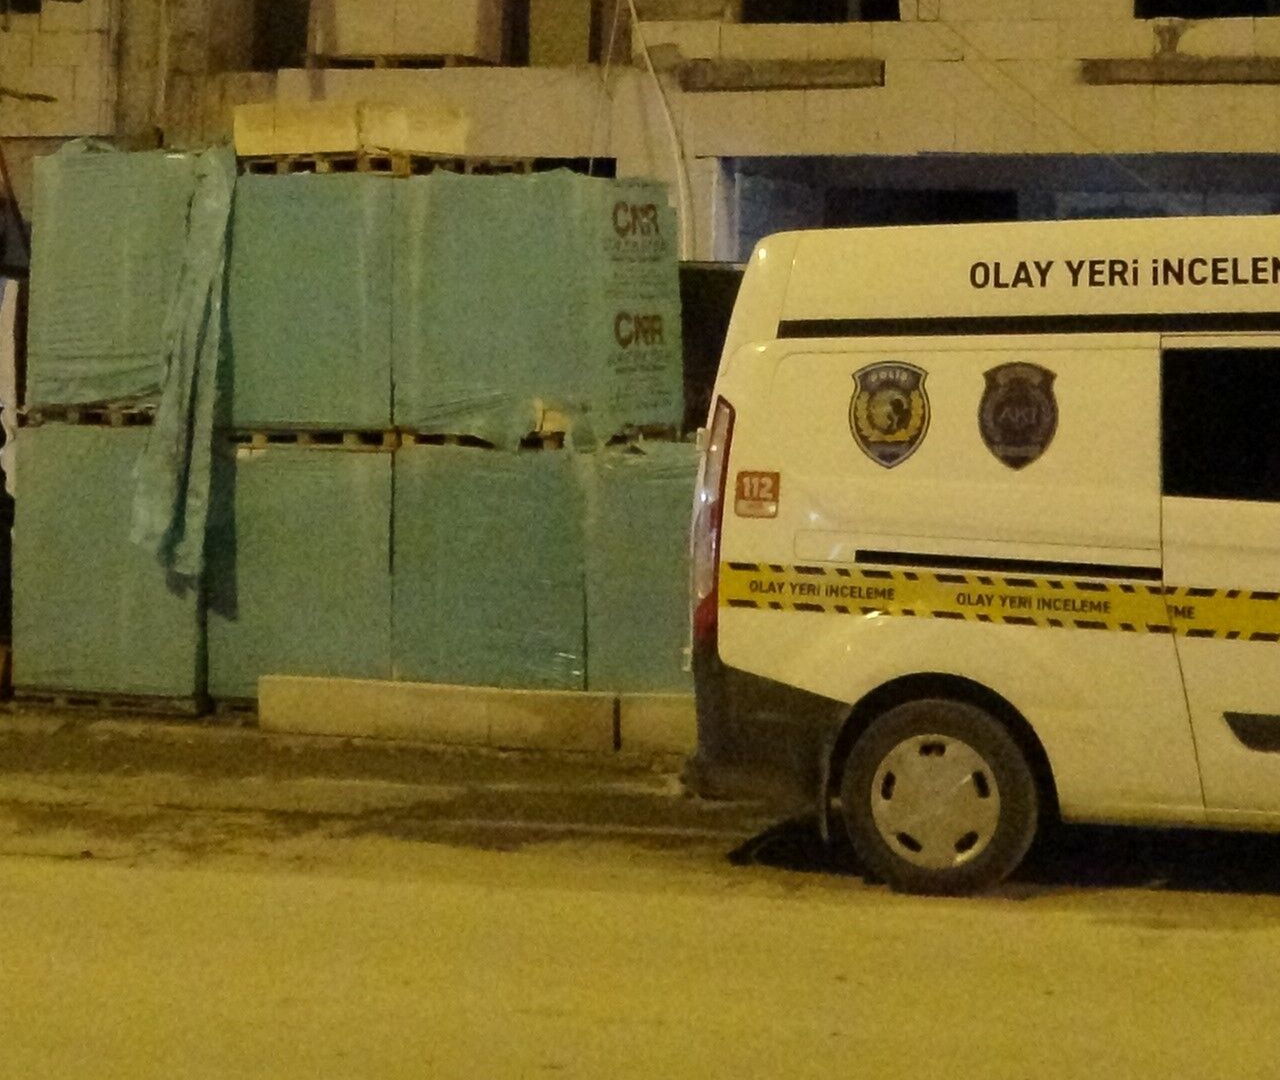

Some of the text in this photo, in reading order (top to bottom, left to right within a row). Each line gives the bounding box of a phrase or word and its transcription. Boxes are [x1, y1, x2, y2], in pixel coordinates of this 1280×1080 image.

[969, 261, 1054, 289] OLAY
[742, 476, 774, 498] 112
[749, 579, 784, 595] OLAY
[956, 592, 995, 608] OLAY
